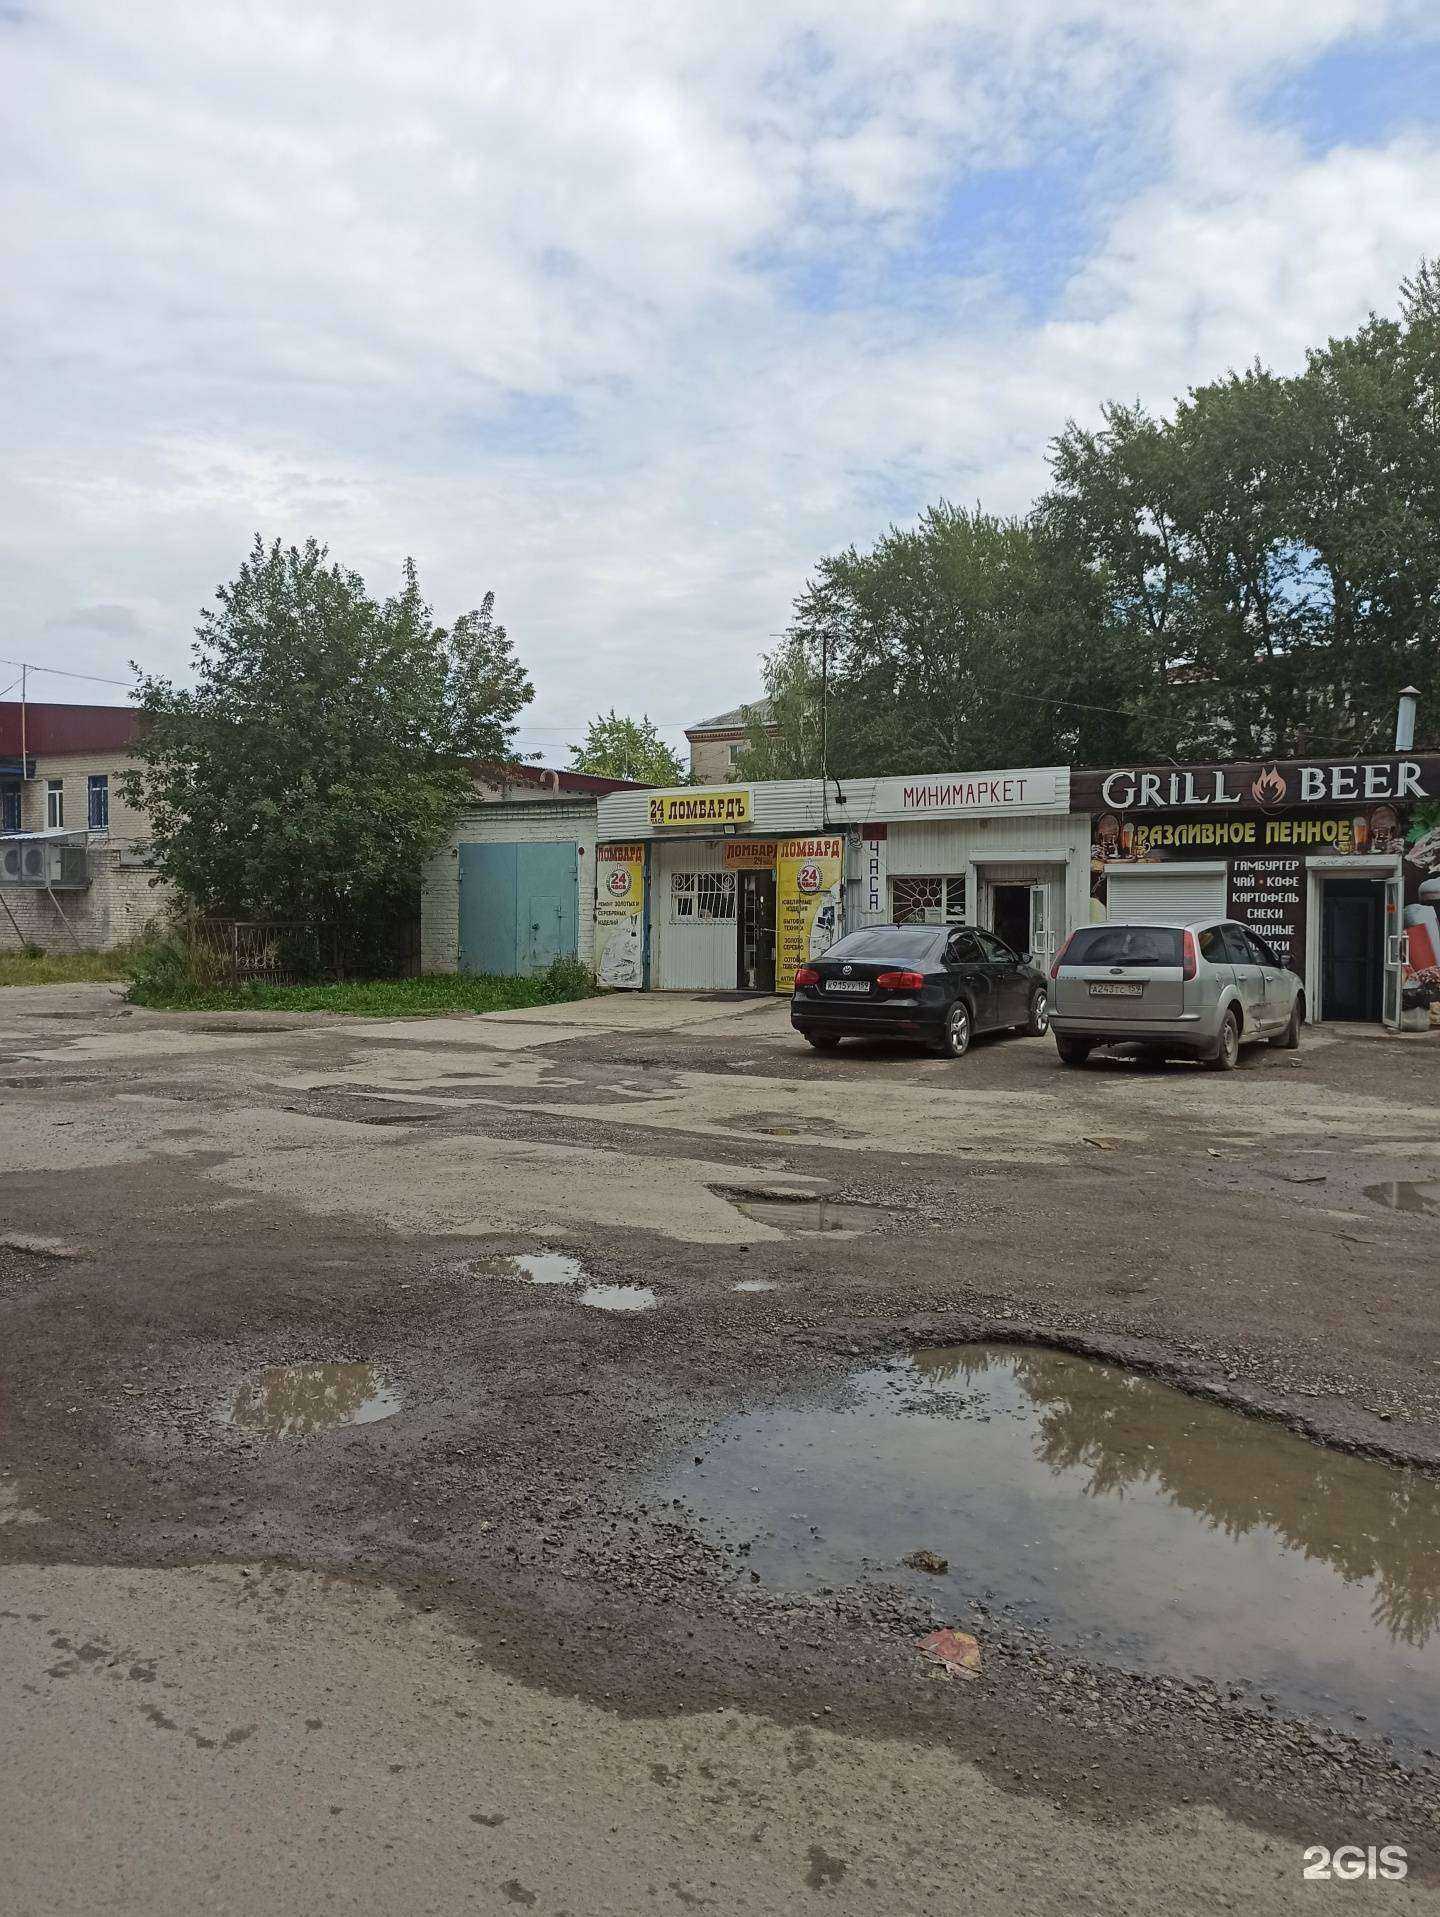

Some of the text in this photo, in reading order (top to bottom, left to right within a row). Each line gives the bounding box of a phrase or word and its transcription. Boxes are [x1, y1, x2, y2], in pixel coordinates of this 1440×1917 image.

[903, 779, 1027, 807] МИНИМАРКЕТ
[1102, 761, 1430, 809] GRILL BEER
[650, 797, 745, 820] 24 ЛОМБАРДЪ
[1136, 820, 1352, 847] РАЗЛИВНОЕ ПЕННОЕ
[598, 846, 642, 863] ЛОМБАРД
[781, 840, 840, 858] ЛОМБАРД
[1234, 860, 1299, 871] ГАМБУРГЕР
[611, 873, 626, 884] 24
[802, 870, 817, 882] 24
[869, 840, 878, 910] ЧАСА
[1233, 874, 1299, 887] ЧАЙ КОФЕ
[1232, 892, 1299, 903] КАРТОФЕЛЬ
[1247, 908, 1283, 919] СНЕКИ
